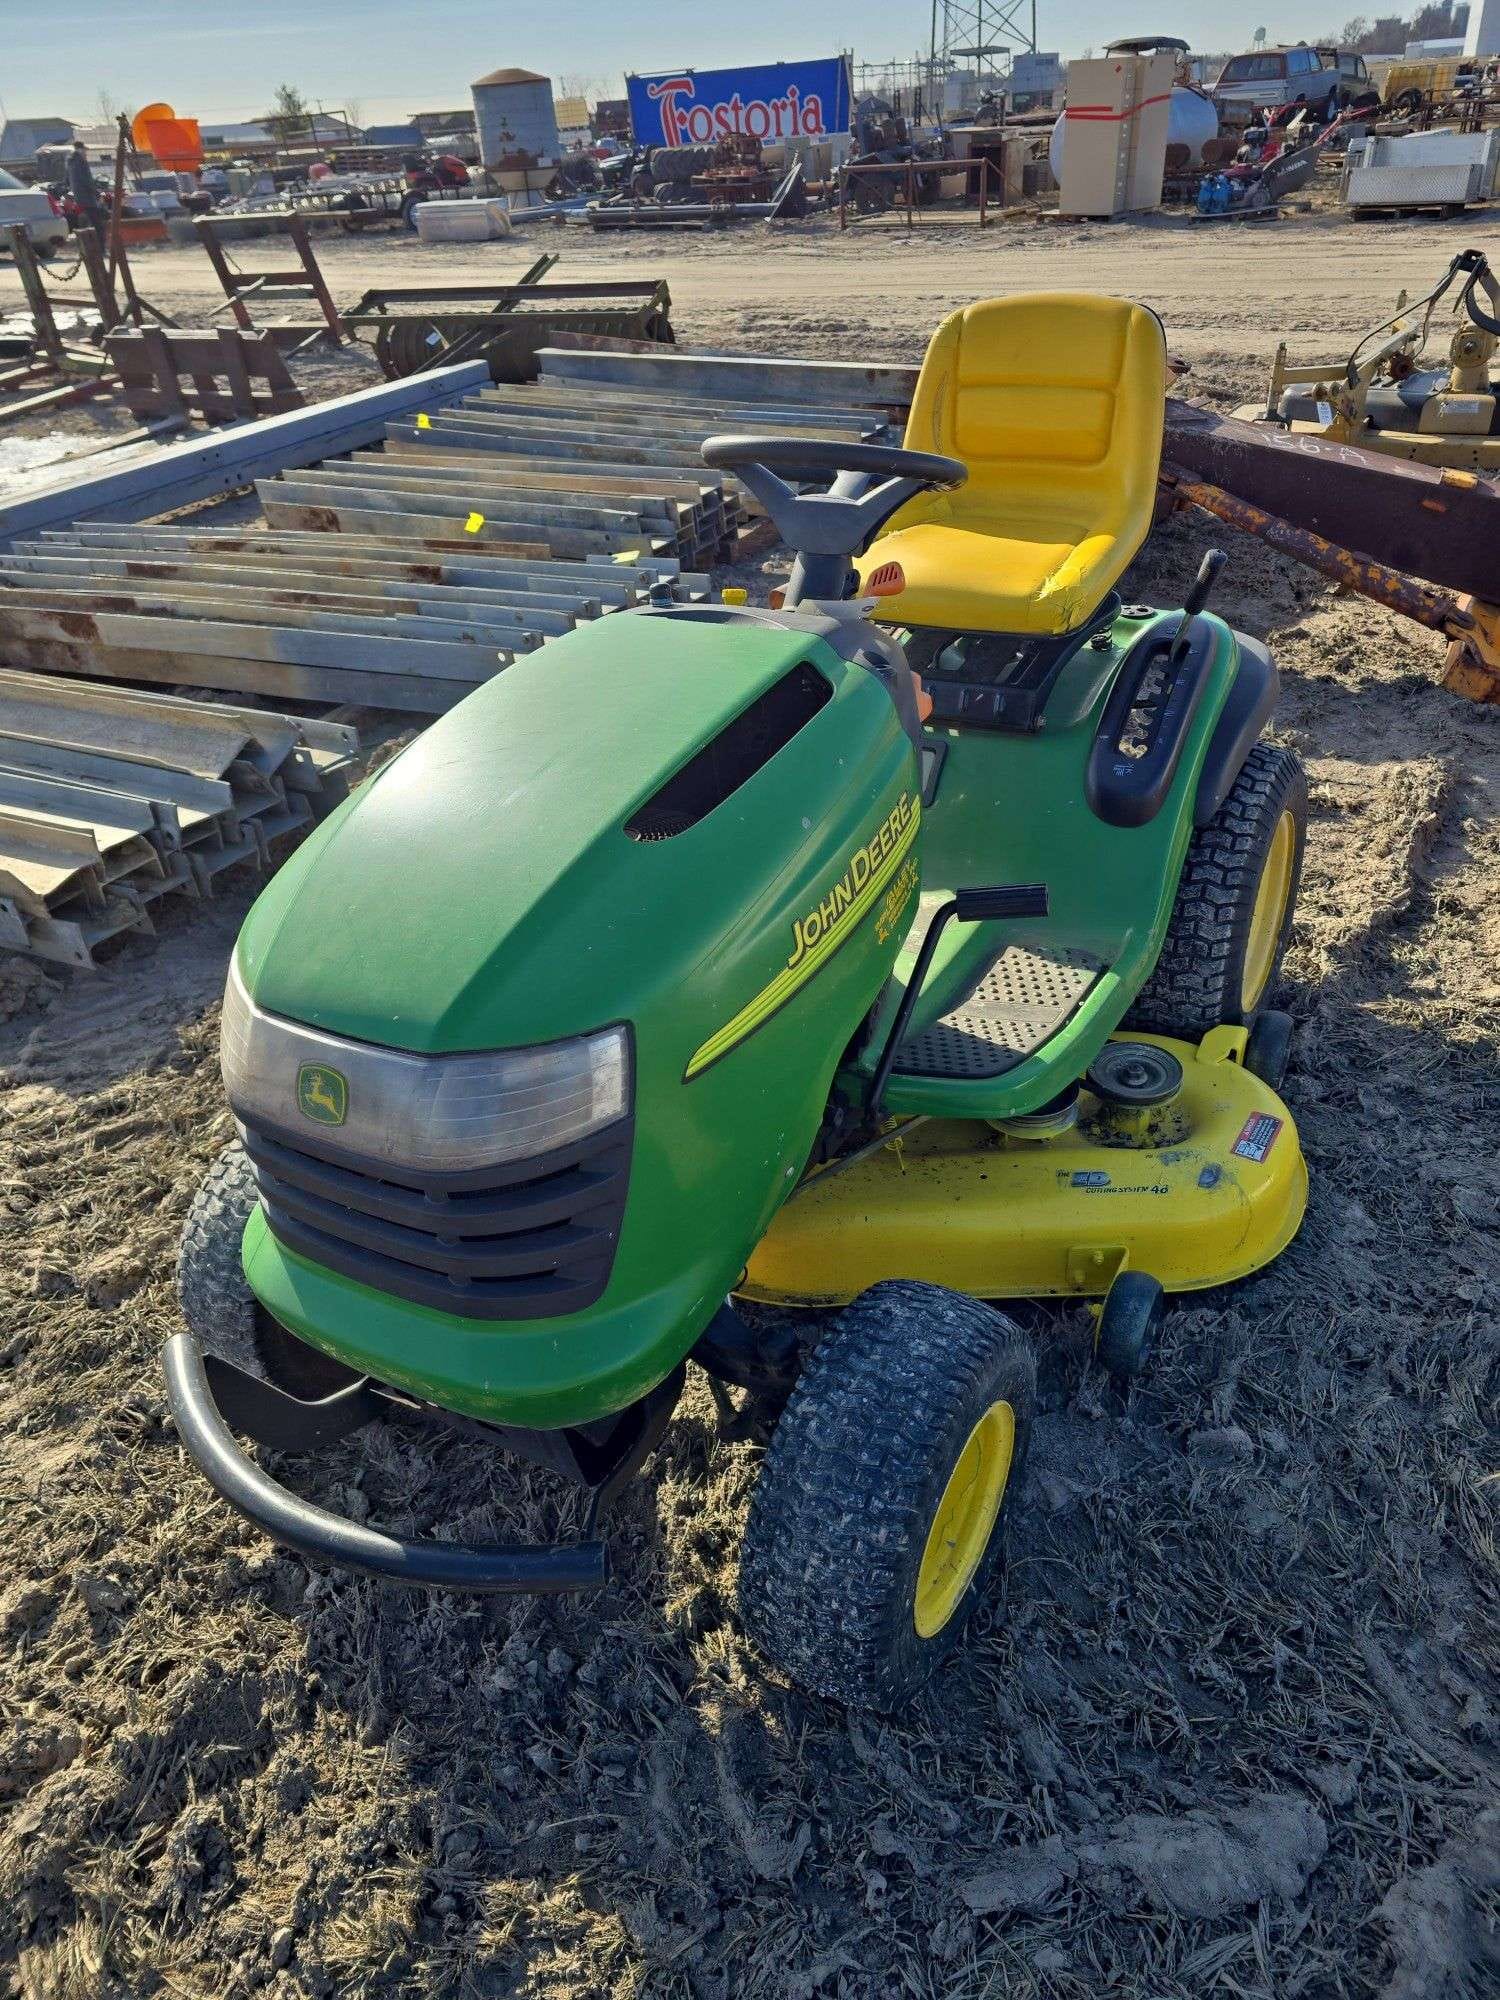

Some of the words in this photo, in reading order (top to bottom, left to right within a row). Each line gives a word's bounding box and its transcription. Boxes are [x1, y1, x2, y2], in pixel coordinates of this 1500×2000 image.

[647, 77, 826, 147] Fostoria
[788, 873, 853, 968] JOHN
[850, 790, 912, 895] DEERE
